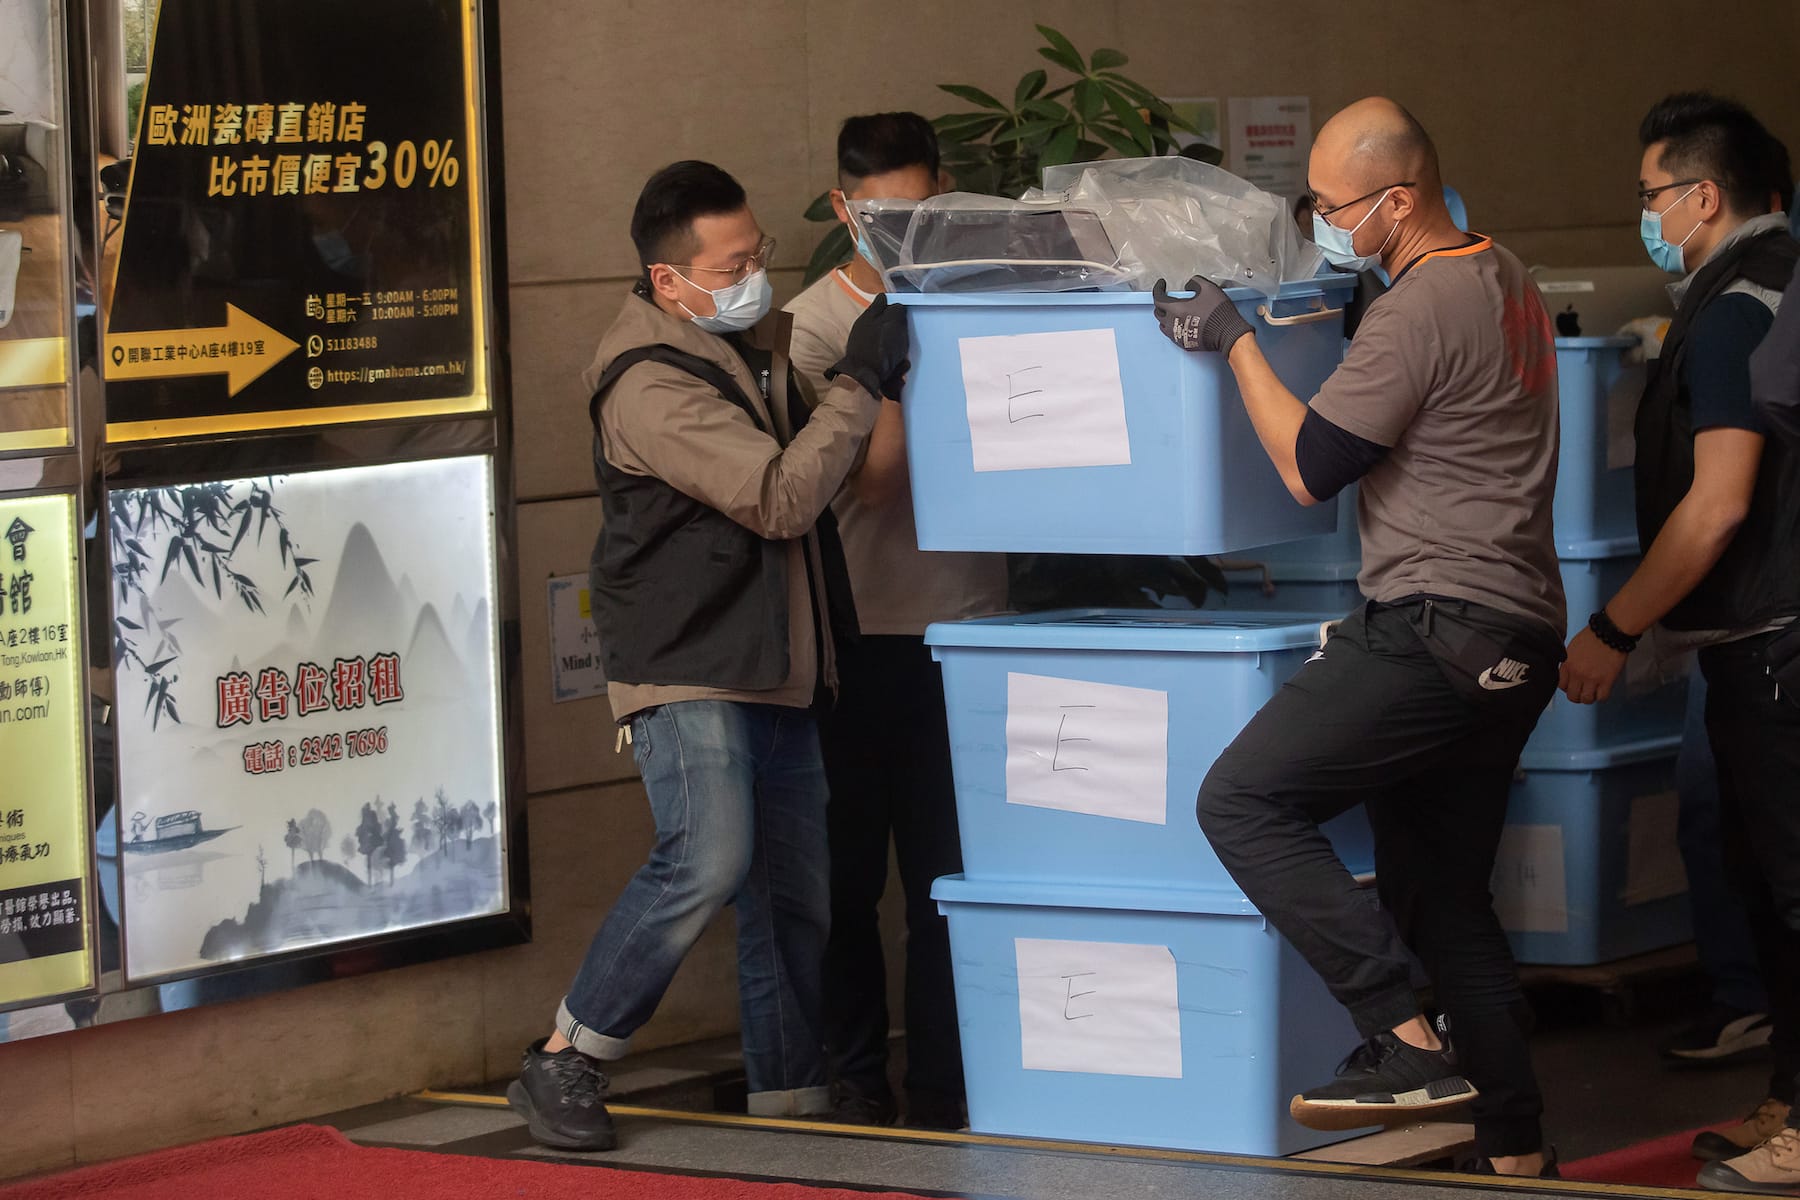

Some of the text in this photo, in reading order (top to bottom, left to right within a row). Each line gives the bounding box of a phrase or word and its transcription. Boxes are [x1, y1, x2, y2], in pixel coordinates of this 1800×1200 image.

[147, 102, 367, 146] 歐洲瓷磚直銷店
[376, 291, 413, 304] 9:00AM
[423, 288, 458, 301] 6:00PM
[372, 306, 414, 320] 10:00AM
[423, 303, 459, 317] 5:00PM
[327, 336, 377, 351] 51183488
[327, 360, 466, 384] https://gmahome.com.hk/
[1006, 365, 1044, 424] E
[1491, 657, 1530, 681] NIKE
[217, 652, 404, 728] 廣告位招租
[301, 733, 343, 765] 2342
[346, 726, 388, 758] 7696
